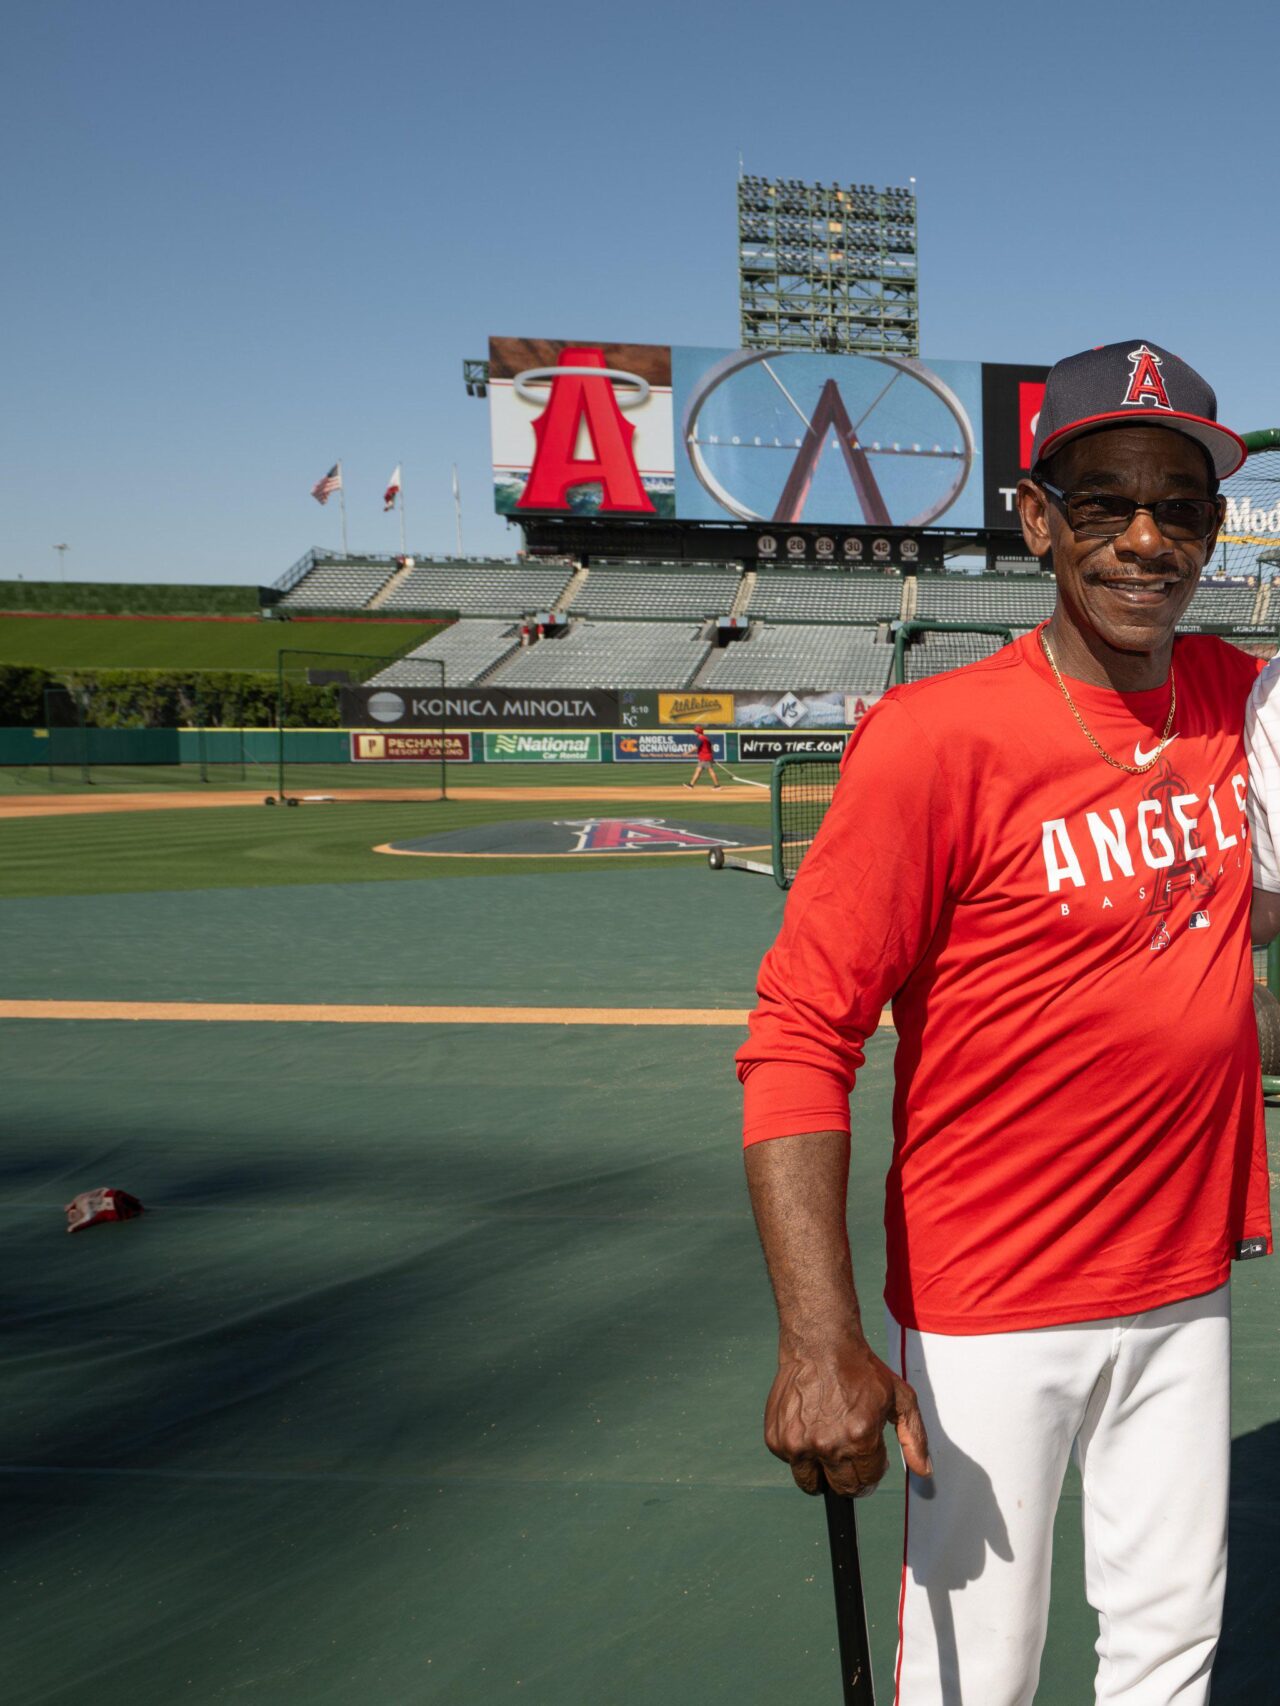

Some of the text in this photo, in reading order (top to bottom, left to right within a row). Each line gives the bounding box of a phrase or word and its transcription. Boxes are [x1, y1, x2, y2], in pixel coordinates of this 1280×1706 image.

[1121, 345, 1174, 411] A
[875, 542, 888, 553] 42
[412, 699, 596, 717] KONICA MINOLTA
[671, 696, 722, 719] Athletics
[782, 699, 799, 718] VS
[622, 712, 638, 728] KC
[388, 738, 463, 748] PECHANGA
[517, 736, 591, 752] National
[743, 740, 844, 753] NITTO TIRE.COM
[1042, 774, 1247, 892] ANGELS
